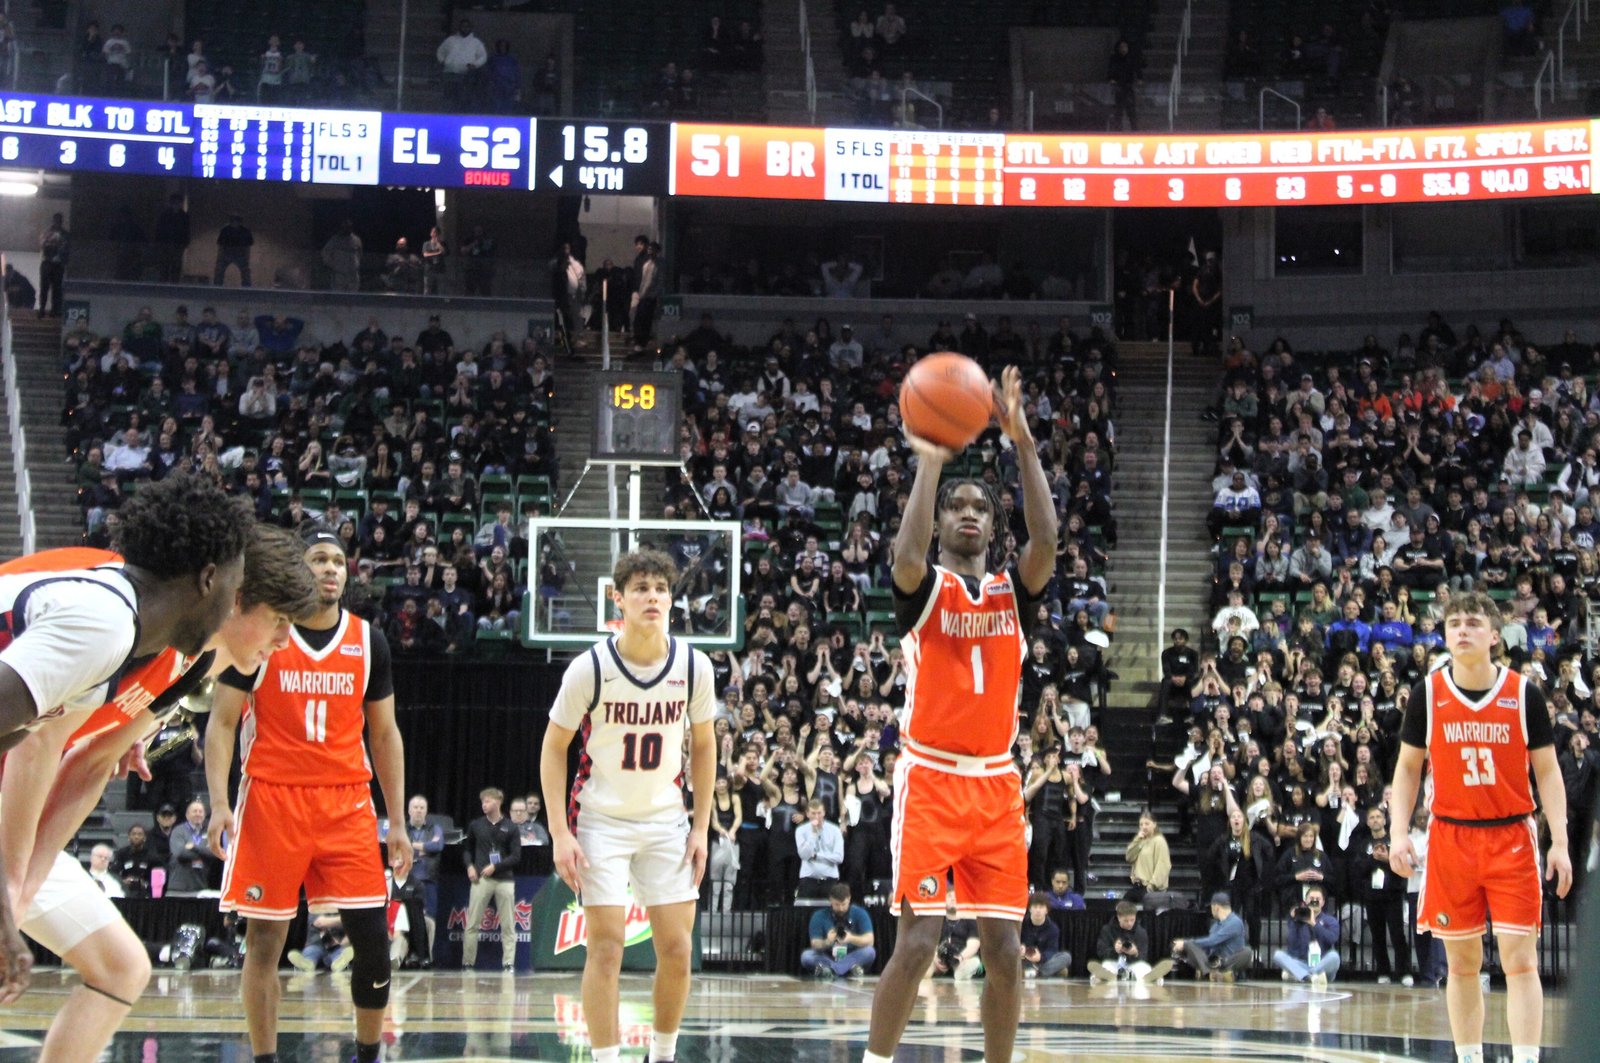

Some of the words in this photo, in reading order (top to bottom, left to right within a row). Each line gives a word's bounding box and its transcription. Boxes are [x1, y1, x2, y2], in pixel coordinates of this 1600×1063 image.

[47, 102, 93, 128] BLK
[104, 106, 134, 131] TO
[146, 109, 190, 134] STL
[319, 122, 352, 137] FLS
[358, 123, 367, 138] 3
[2, 136, 19, 160] 6
[60, 141, 77, 164] 3
[109, 144, 125, 167] 6
[158, 147, 175, 170] 4
[393, 127, 440, 165] EL
[460, 125, 521, 170] 52
[562, 125, 648, 164] 15.8
[690, 133, 740, 177] 51
[766, 140, 815, 178] BR
[836, 140, 846, 156] 5
[852, 141, 883, 157] FLS
[1008, 142, 1050, 164] STL
[1154, 142, 1199, 165] AST
[317, 155, 350, 171] TOL
[357, 156, 362, 172] 1
[464, 170, 511, 187] BONUS
[579, 166, 624, 190] 4TH
[841, 172, 846, 188] 1
[851, 173, 883, 190] TOL
[1020, 178, 1036, 200] 2
[1063, 178, 1085, 200] 12
[1113, 178, 1129, 201] 2
[1168, 178, 1184, 201] 3
[1276, 177, 1305, 199] 23
[1337, 175, 1353, 198] 5
[1423, 172, 1469, 196] 55.6
[1481, 168, 1528, 192] 40.0
[1543, 165, 1590, 190] 54.1
[1091, 312, 1113, 324] 102
[1232, 313, 1250, 324] 102
[940, 608, 1015, 638] WARRIORS
[279, 670, 355, 696] WARRIORS
[971, 645, 984, 694] 1
[305, 700, 327, 742] 11
[603, 700, 685, 725] TROJANS
[1442, 721, 1511, 744] WARRIORS
[621, 732, 663, 771] 10
[1461, 747, 1496, 786] 33
